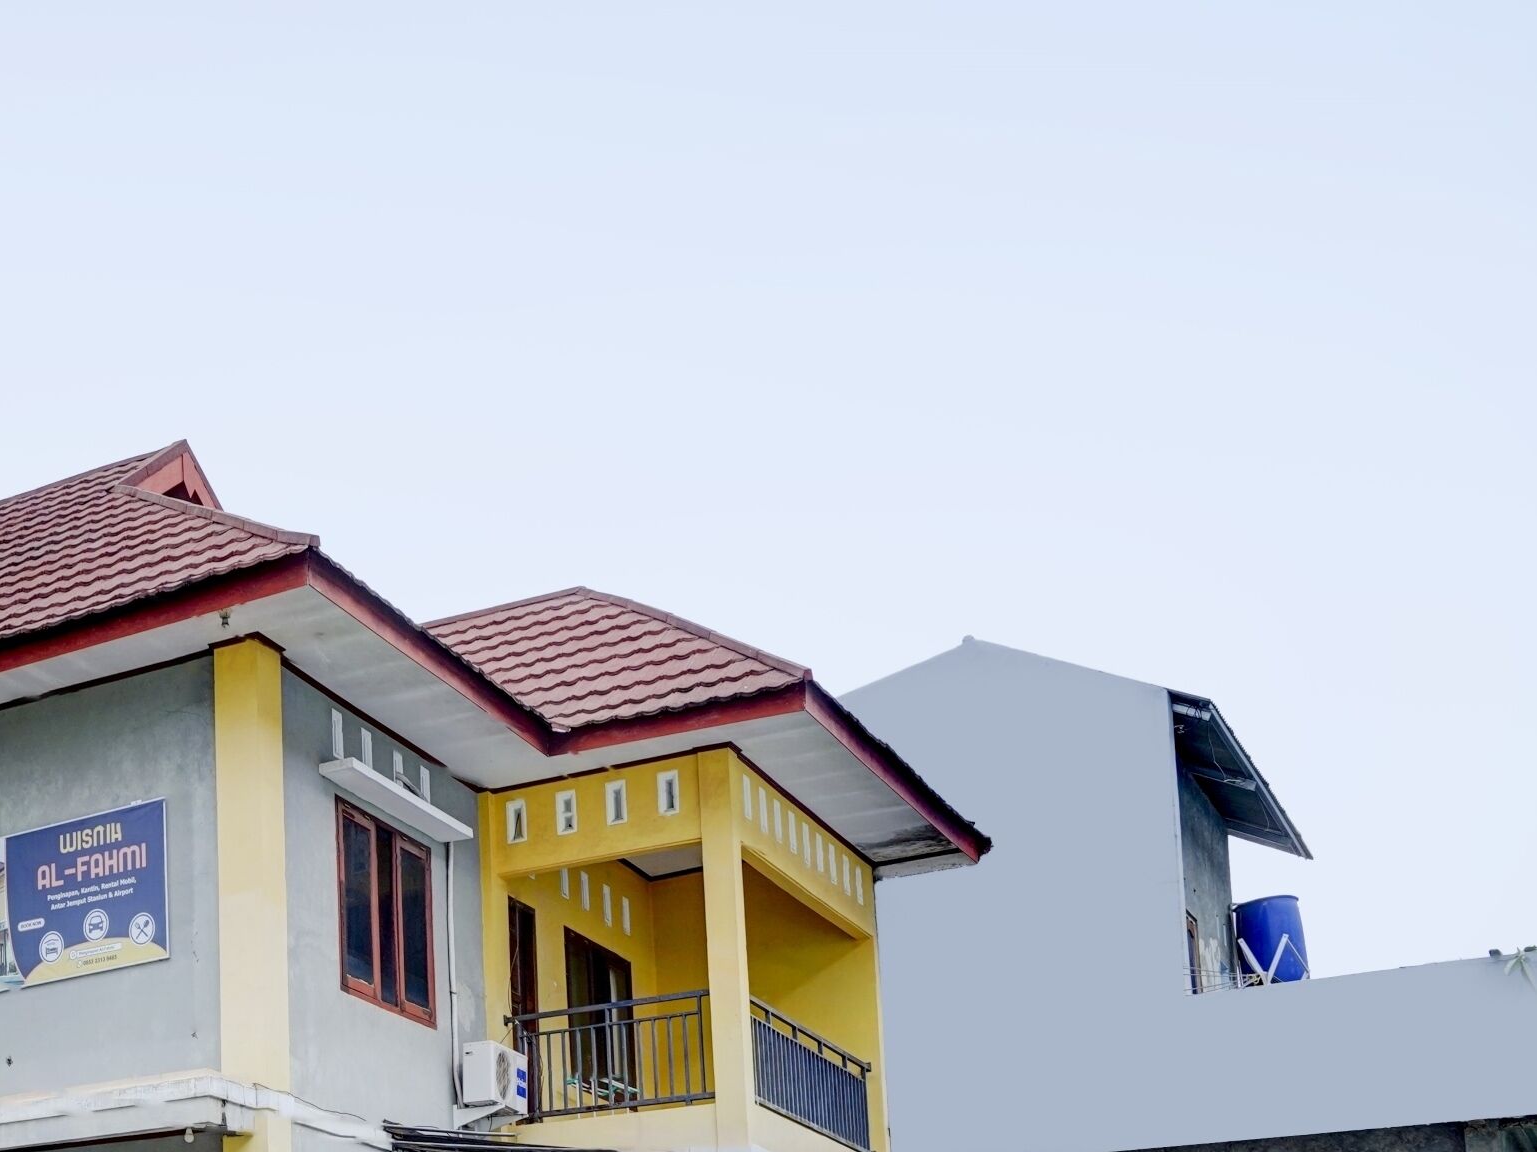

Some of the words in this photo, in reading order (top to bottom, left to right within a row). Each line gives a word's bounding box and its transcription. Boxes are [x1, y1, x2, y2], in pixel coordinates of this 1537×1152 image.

[37, 842, 147, 890] AL-FAHMI
[101, 880, 119, 890] Rental
[51, 902, 66, 911] Antar
[66, 897, 87, 908] Jemput
[114, 887, 134, 898] Airport
